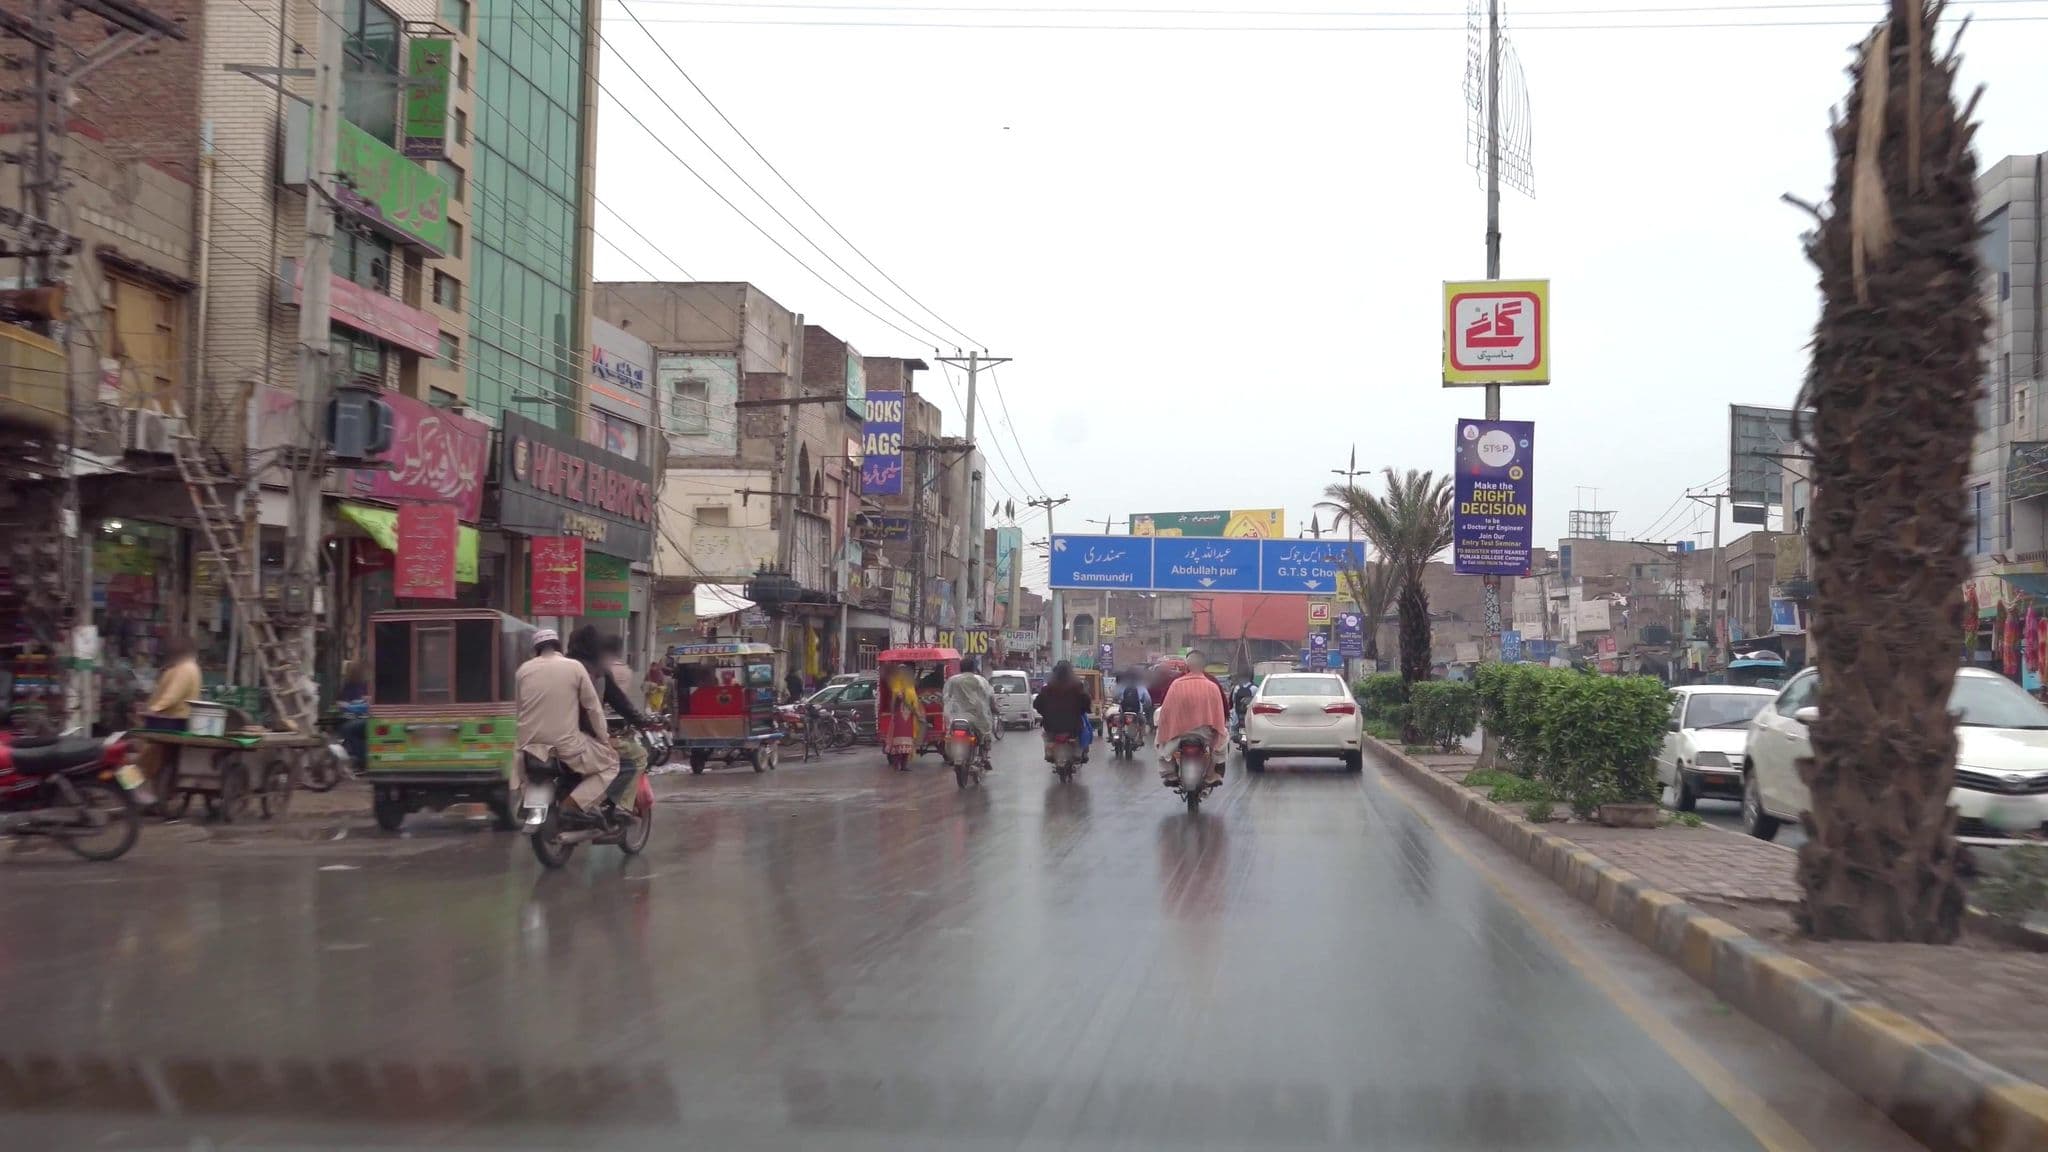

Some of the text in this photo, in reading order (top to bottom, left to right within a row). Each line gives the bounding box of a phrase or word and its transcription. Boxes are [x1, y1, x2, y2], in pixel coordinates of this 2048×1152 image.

[1466, 301, 1524, 348] گائے
[865, 400, 901, 423] OOKS
[1483, 445, 1509, 453] STOP
[531, 441, 654, 524] HAFIZ FABRICS
[1474, 481, 1497, 490] Make
[1473, 490, 1515, 502] RIGHT
[1461, 503, 1527, 515] DECISION
[1084, 546, 1127, 564] سمندری
[1279, 545, 1301, 565] چوک
[1072, 571, 1134, 582] Sammundri
[1171, 565, 1238, 577] Abdullah pur
[1278, 567, 1337, 577] G.T.S Cho
